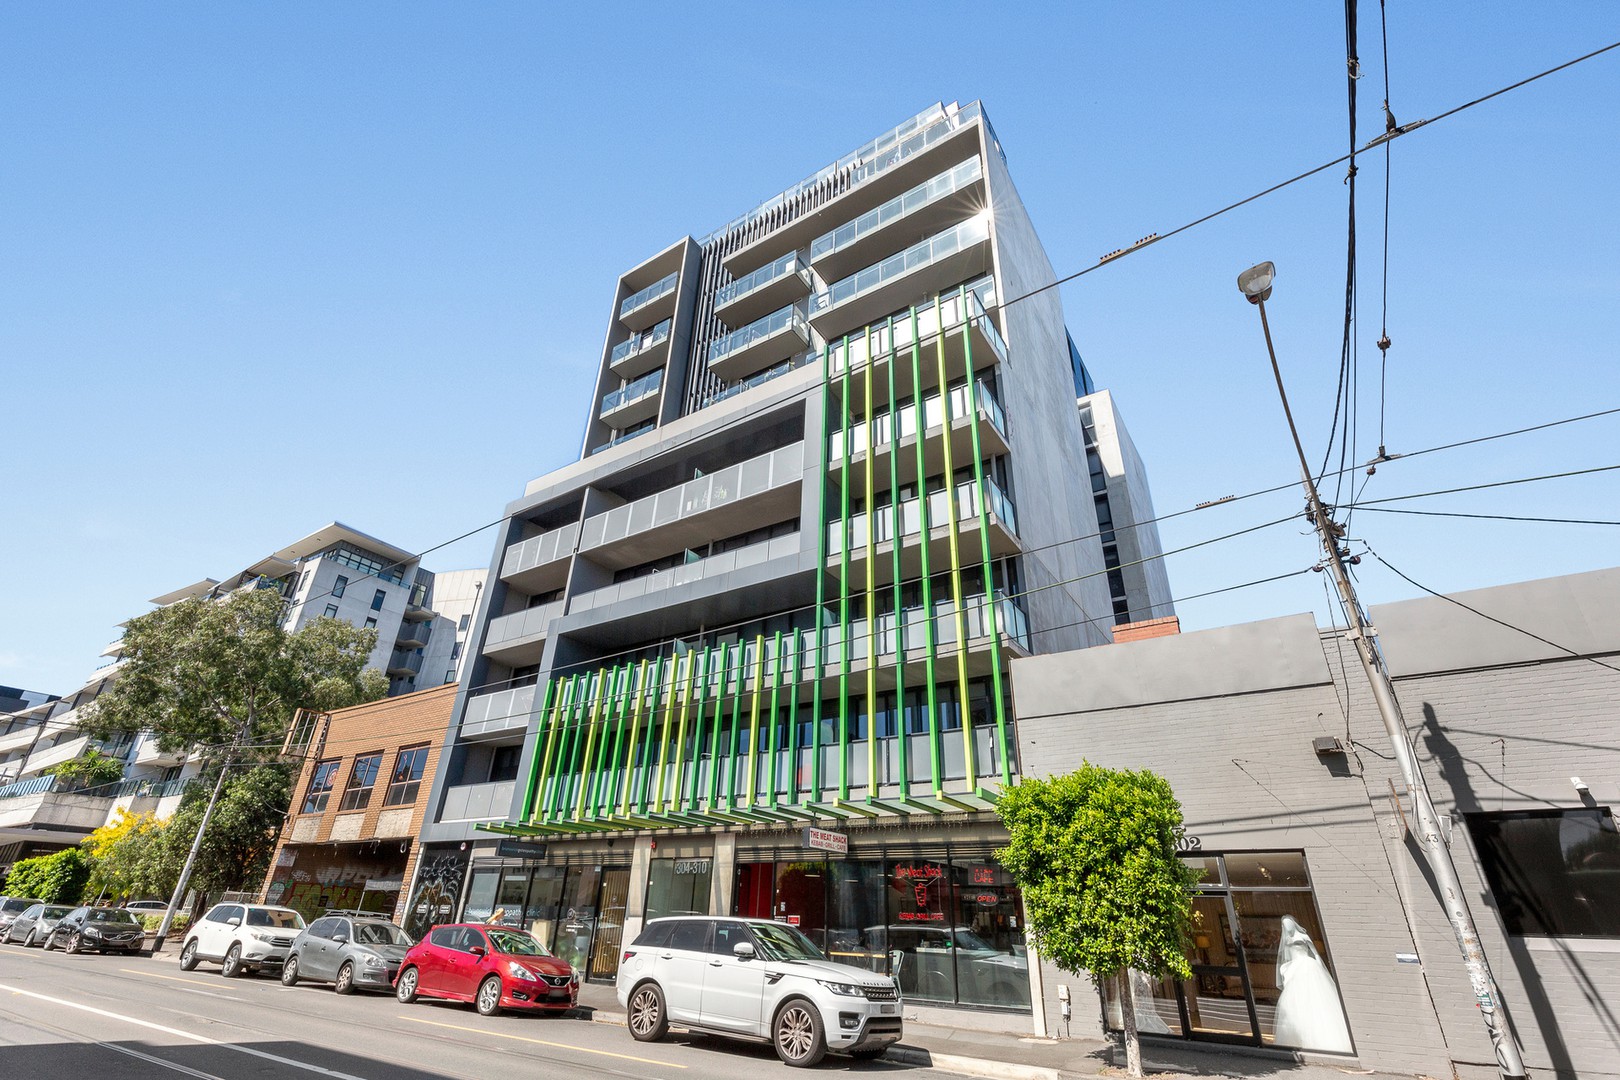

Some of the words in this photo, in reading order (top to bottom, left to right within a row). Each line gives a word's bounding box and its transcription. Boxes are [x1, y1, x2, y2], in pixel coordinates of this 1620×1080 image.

[810, 831, 819, 839] THE
[820, 833, 832, 841] MEAT
[832, 835, 847, 845] SHACK
[1425, 833, 1439, 843] 43
[676, 861, 708, 875] 304-310
[977, 895, 997, 903] OPEN
